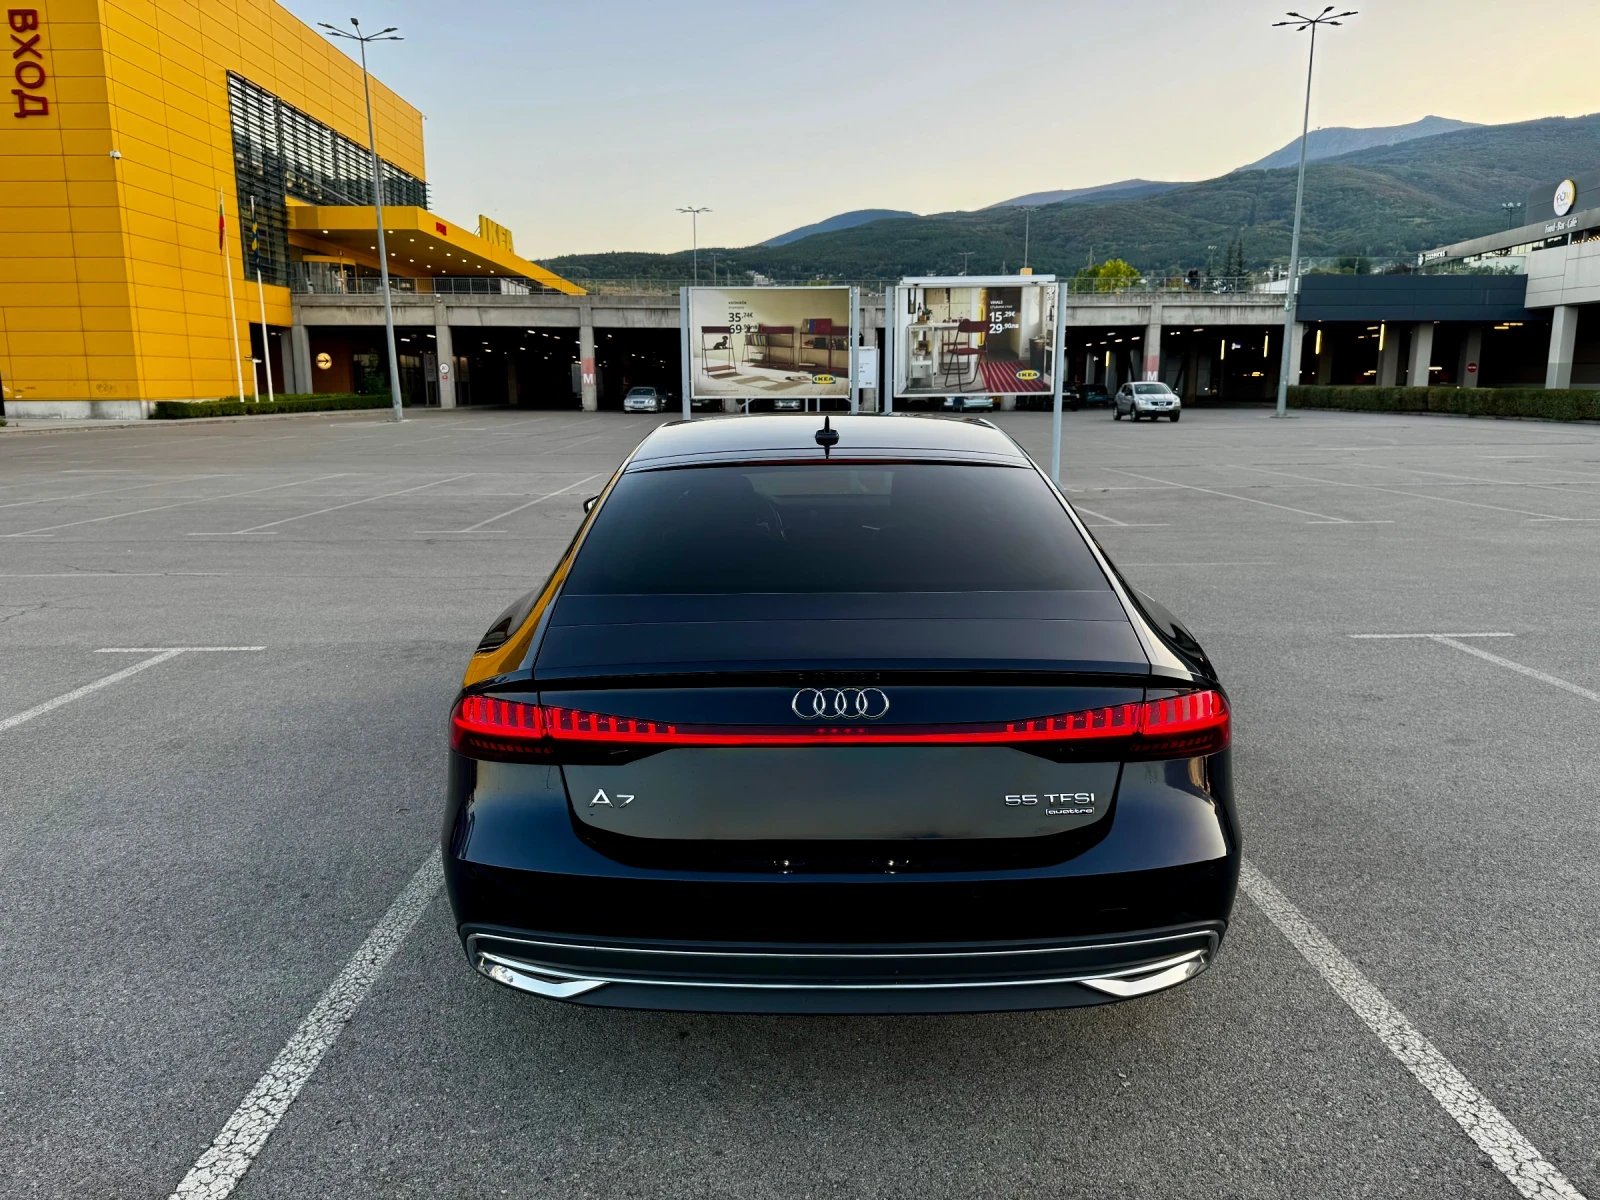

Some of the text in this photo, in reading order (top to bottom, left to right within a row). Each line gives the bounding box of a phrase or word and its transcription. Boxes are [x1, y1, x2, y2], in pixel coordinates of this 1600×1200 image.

[8, 9, 49, 118] ВХОД
[479, 214, 514, 255] IKEA
[583, 373, 594, 384] M
[1147, 371, 1158, 381] M
[1005, 792, 1095, 806] 55 TFSI
